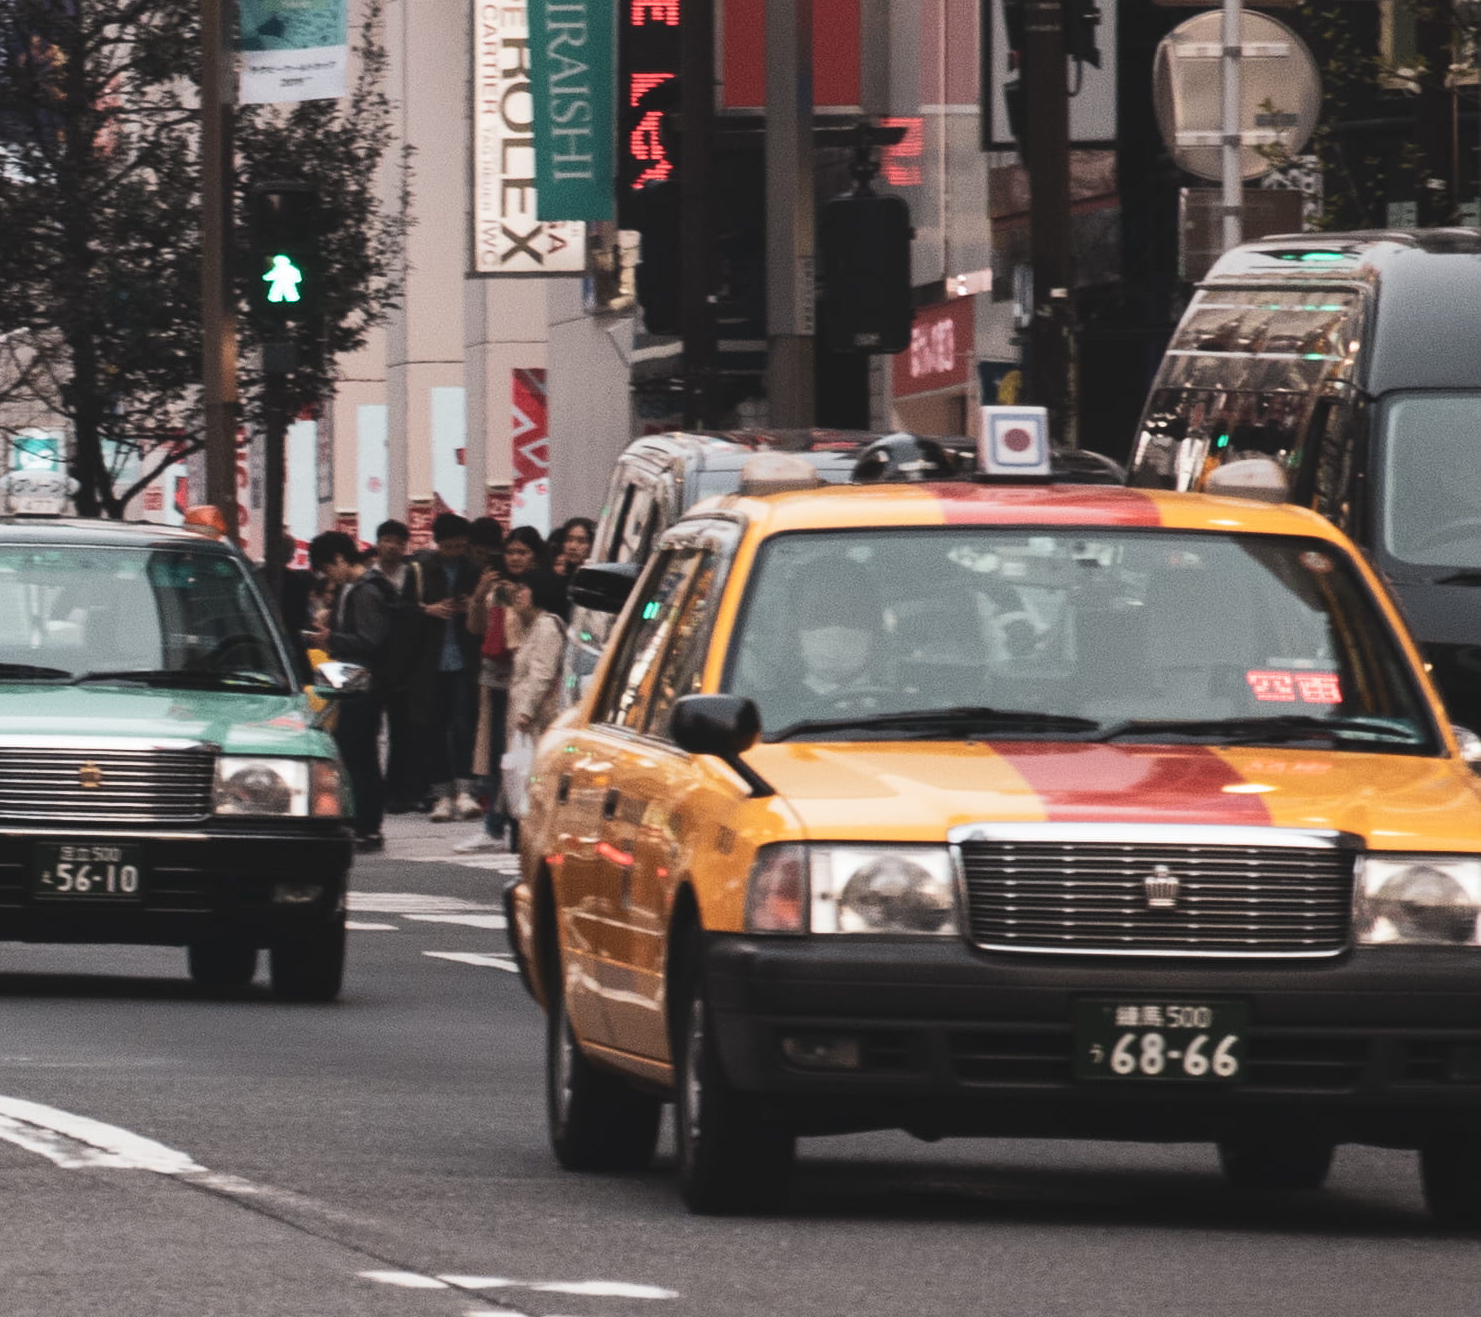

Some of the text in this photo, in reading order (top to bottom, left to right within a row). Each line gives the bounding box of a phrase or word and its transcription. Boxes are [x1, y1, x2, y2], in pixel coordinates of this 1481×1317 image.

[481, 4, 499, 115] CARTIER
[499, 37, 543, 267] ROLEX
[480, 219, 499, 269] IWC
[55, 863, 139, 893] 56-10
[1165, 1005, 1213, 1029] 500
[1109, 1032, 1240, 1077] 68-66
